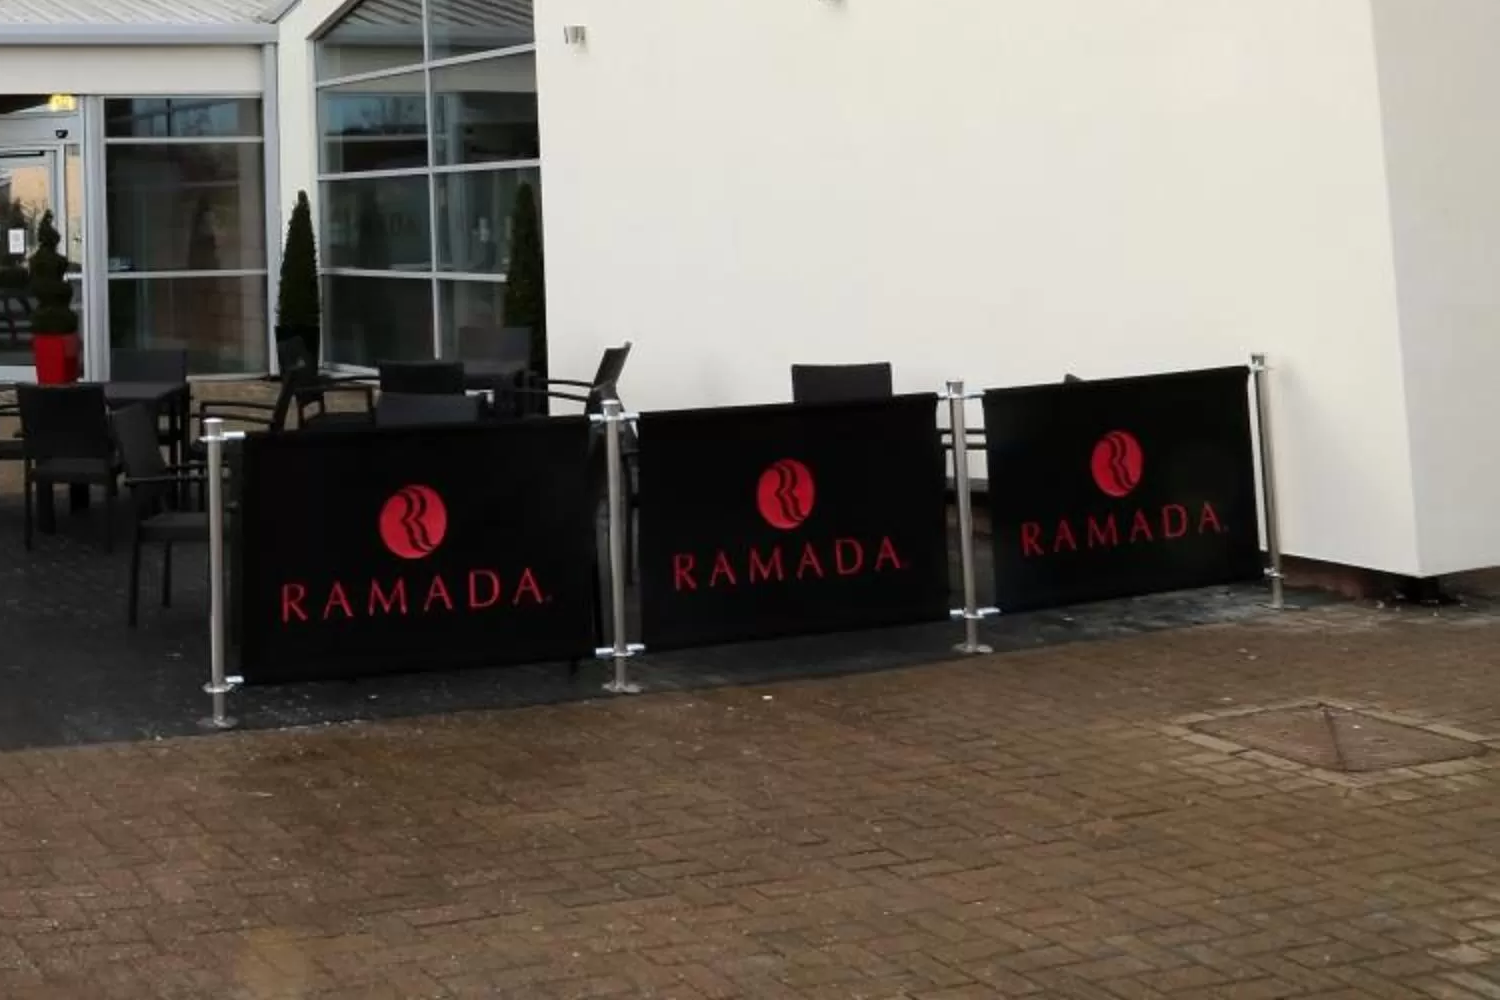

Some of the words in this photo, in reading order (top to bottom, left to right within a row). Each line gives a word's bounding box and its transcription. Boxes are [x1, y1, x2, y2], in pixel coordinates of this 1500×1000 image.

[1020, 500, 1222, 557] RAMADA
[672, 535, 902, 591] RAMADA
[280, 567, 544, 623] RAMADA
